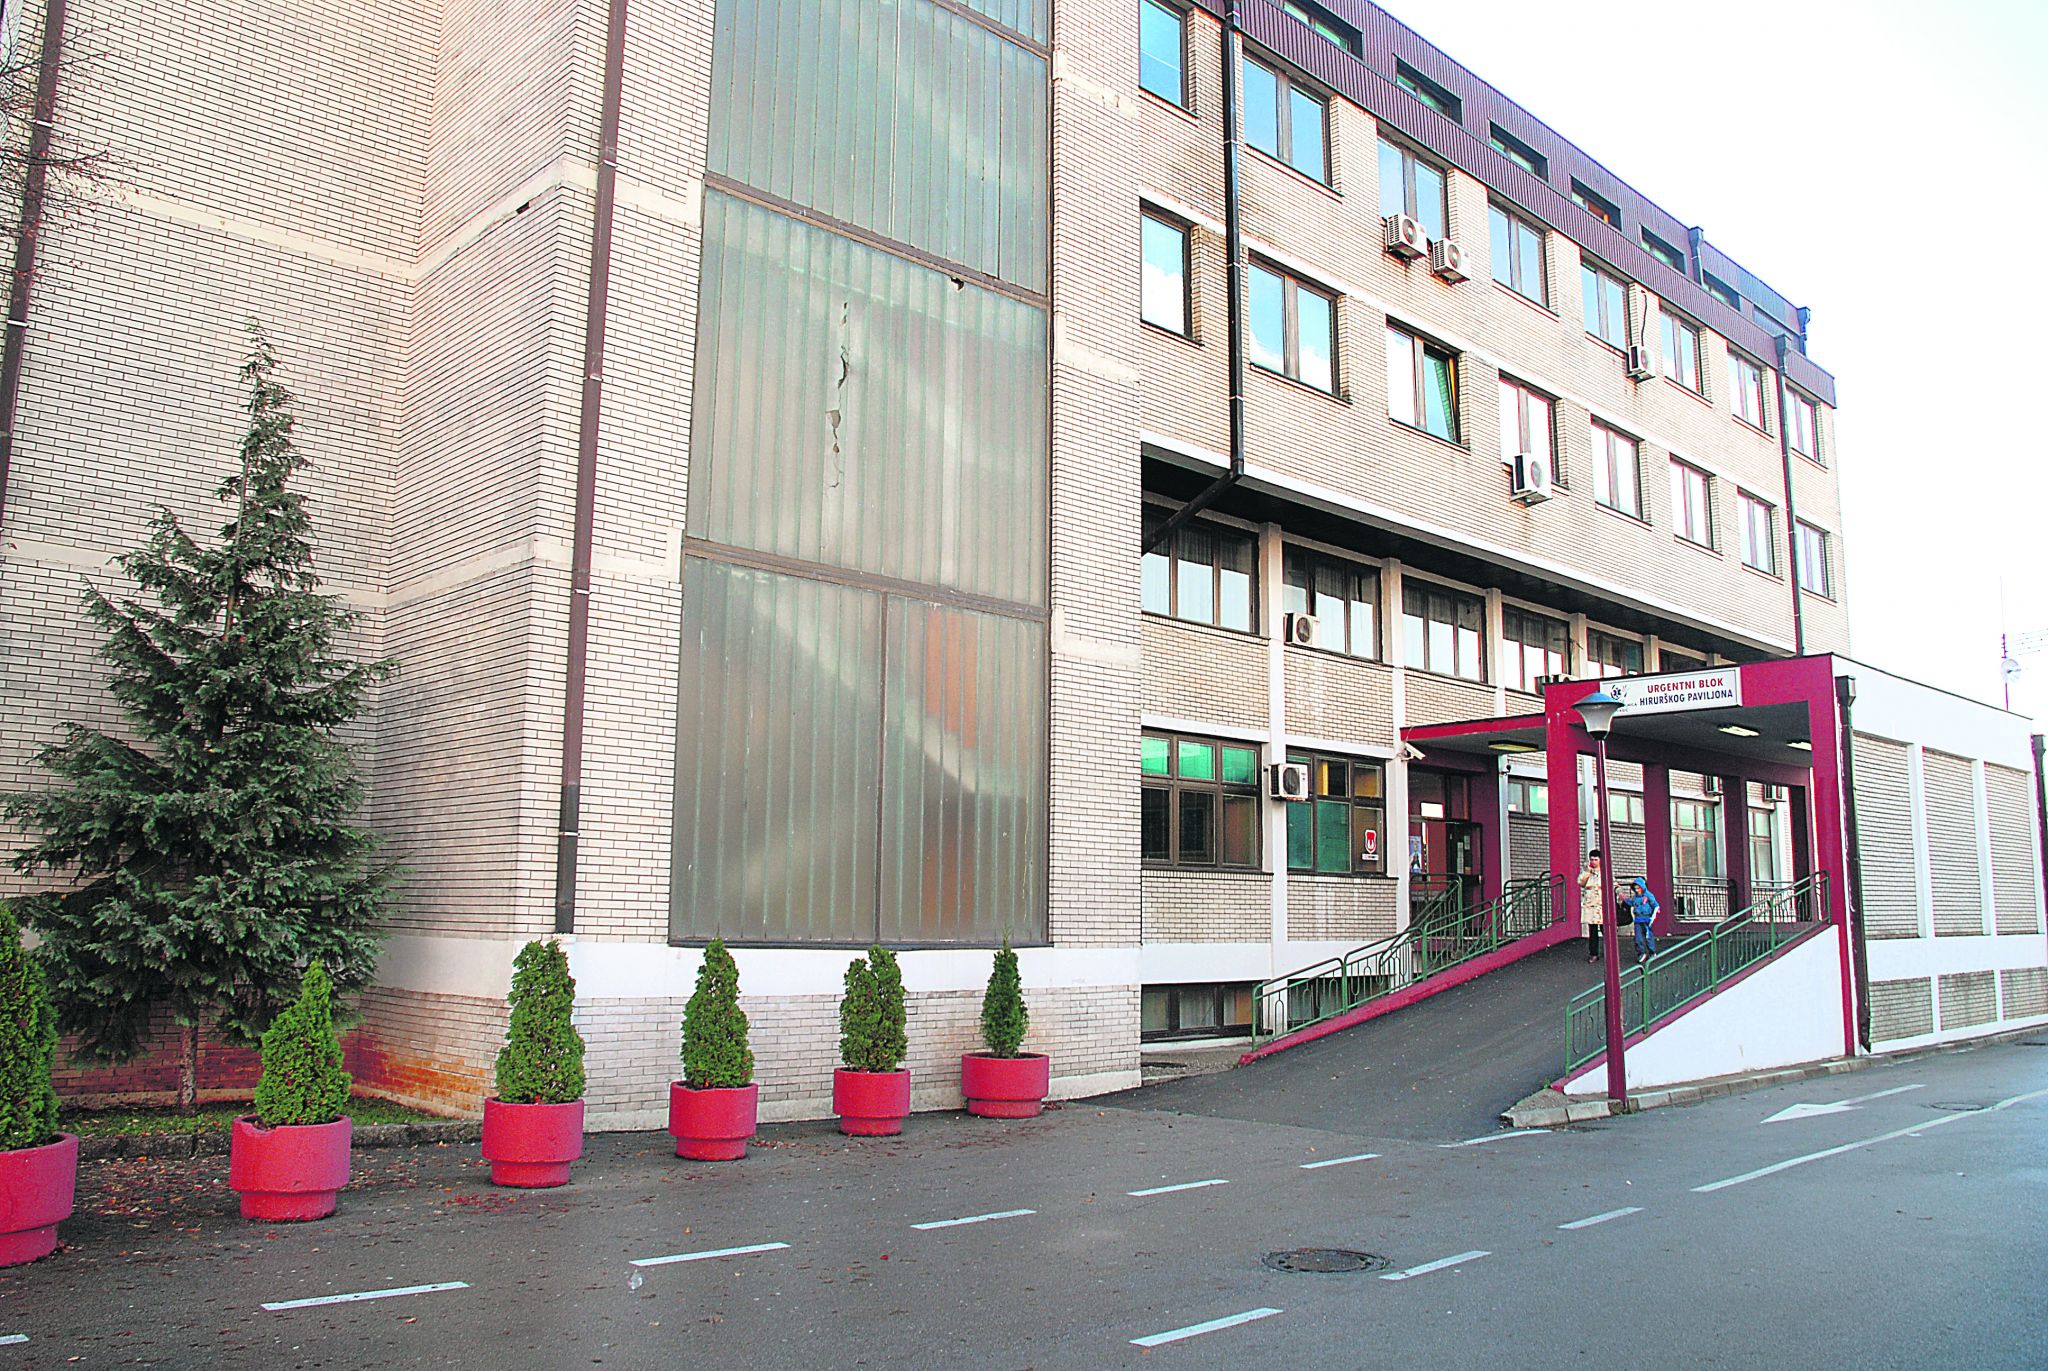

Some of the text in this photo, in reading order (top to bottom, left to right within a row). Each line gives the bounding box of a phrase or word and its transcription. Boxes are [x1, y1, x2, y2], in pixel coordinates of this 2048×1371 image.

[1647, 678, 1723, 693] URGENTNI BLOK
[1639, 689, 1733, 706] HIRURŠKOG PAVILJONA
